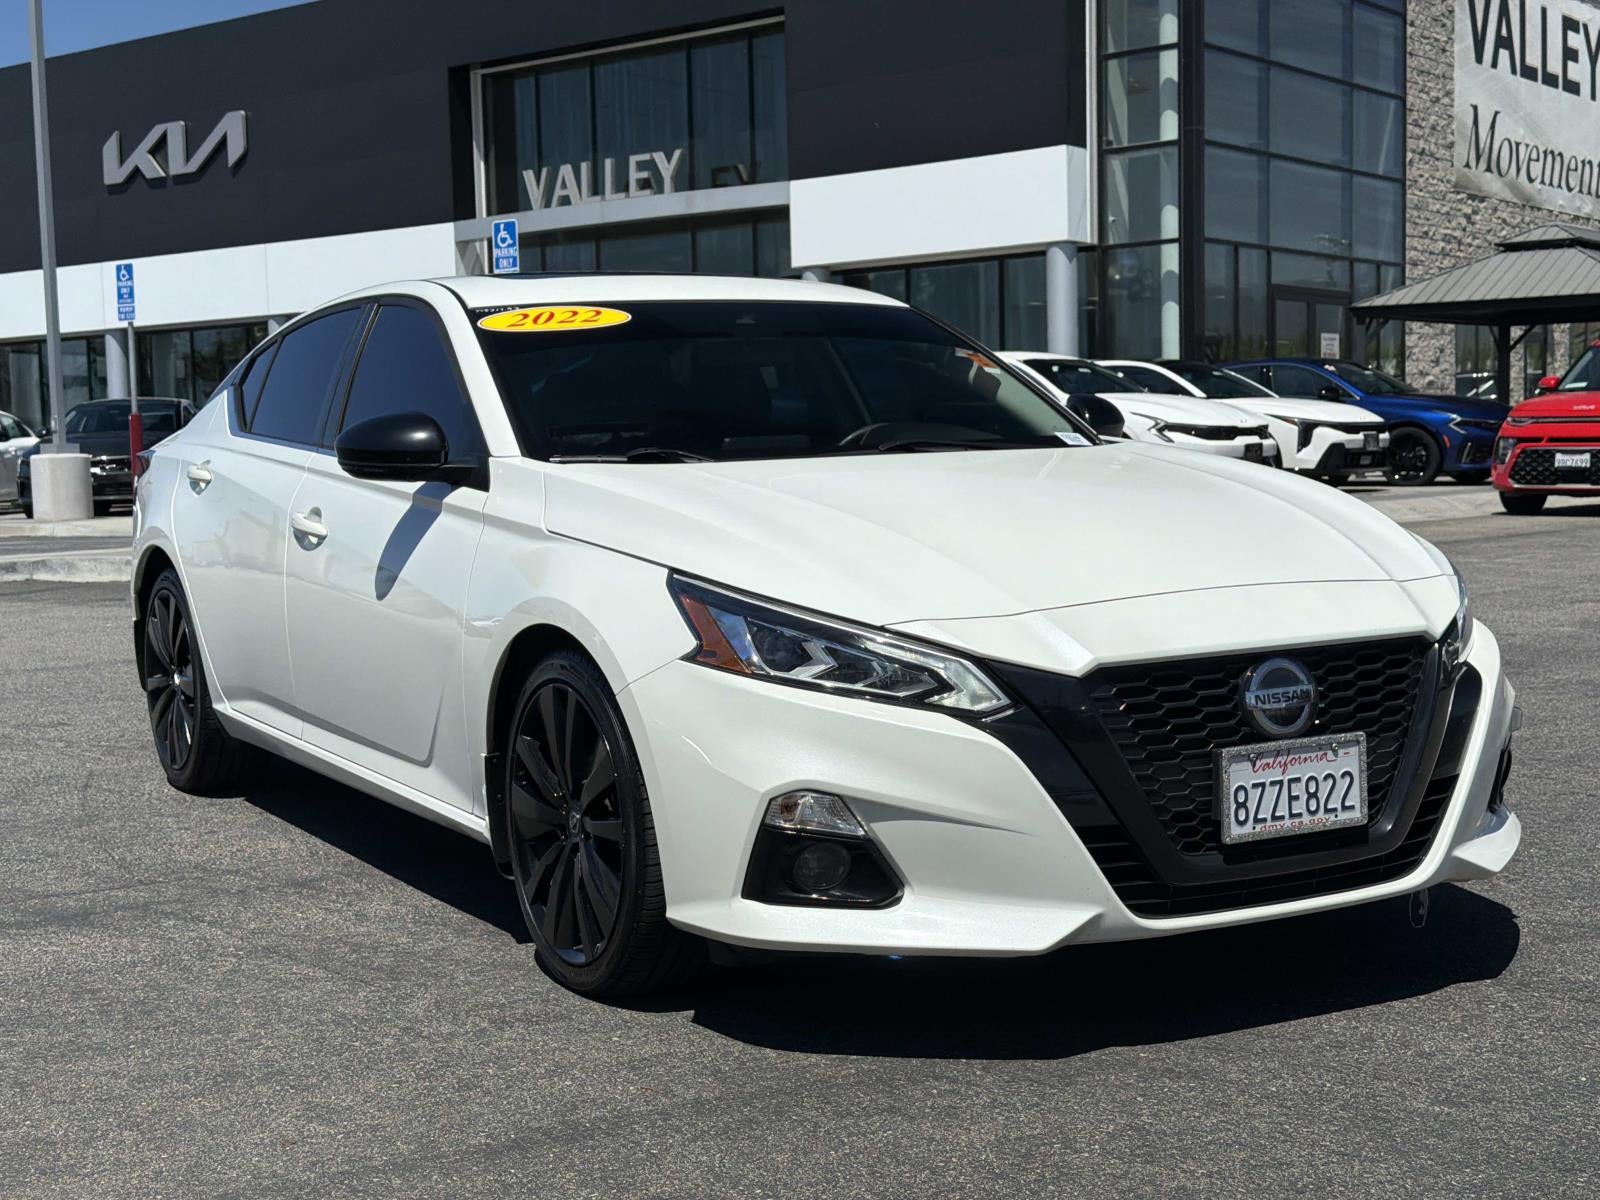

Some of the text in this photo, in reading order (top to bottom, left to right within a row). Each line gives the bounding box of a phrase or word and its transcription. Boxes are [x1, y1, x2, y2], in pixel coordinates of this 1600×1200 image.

[1468, 0, 1600, 102] VALLEY
[102, 109, 249, 186] KIA
[522, 148, 683, 211] VALLEY
[494, 247, 518, 258] PARKING
[498, 257, 513, 268] ONLY
[506, 309, 602, 328] 2022
[1254, 687, 1312, 706] NISSAN
[1252, 750, 1337, 775] California
[1233, 770, 1356, 827] 8ZZE822
